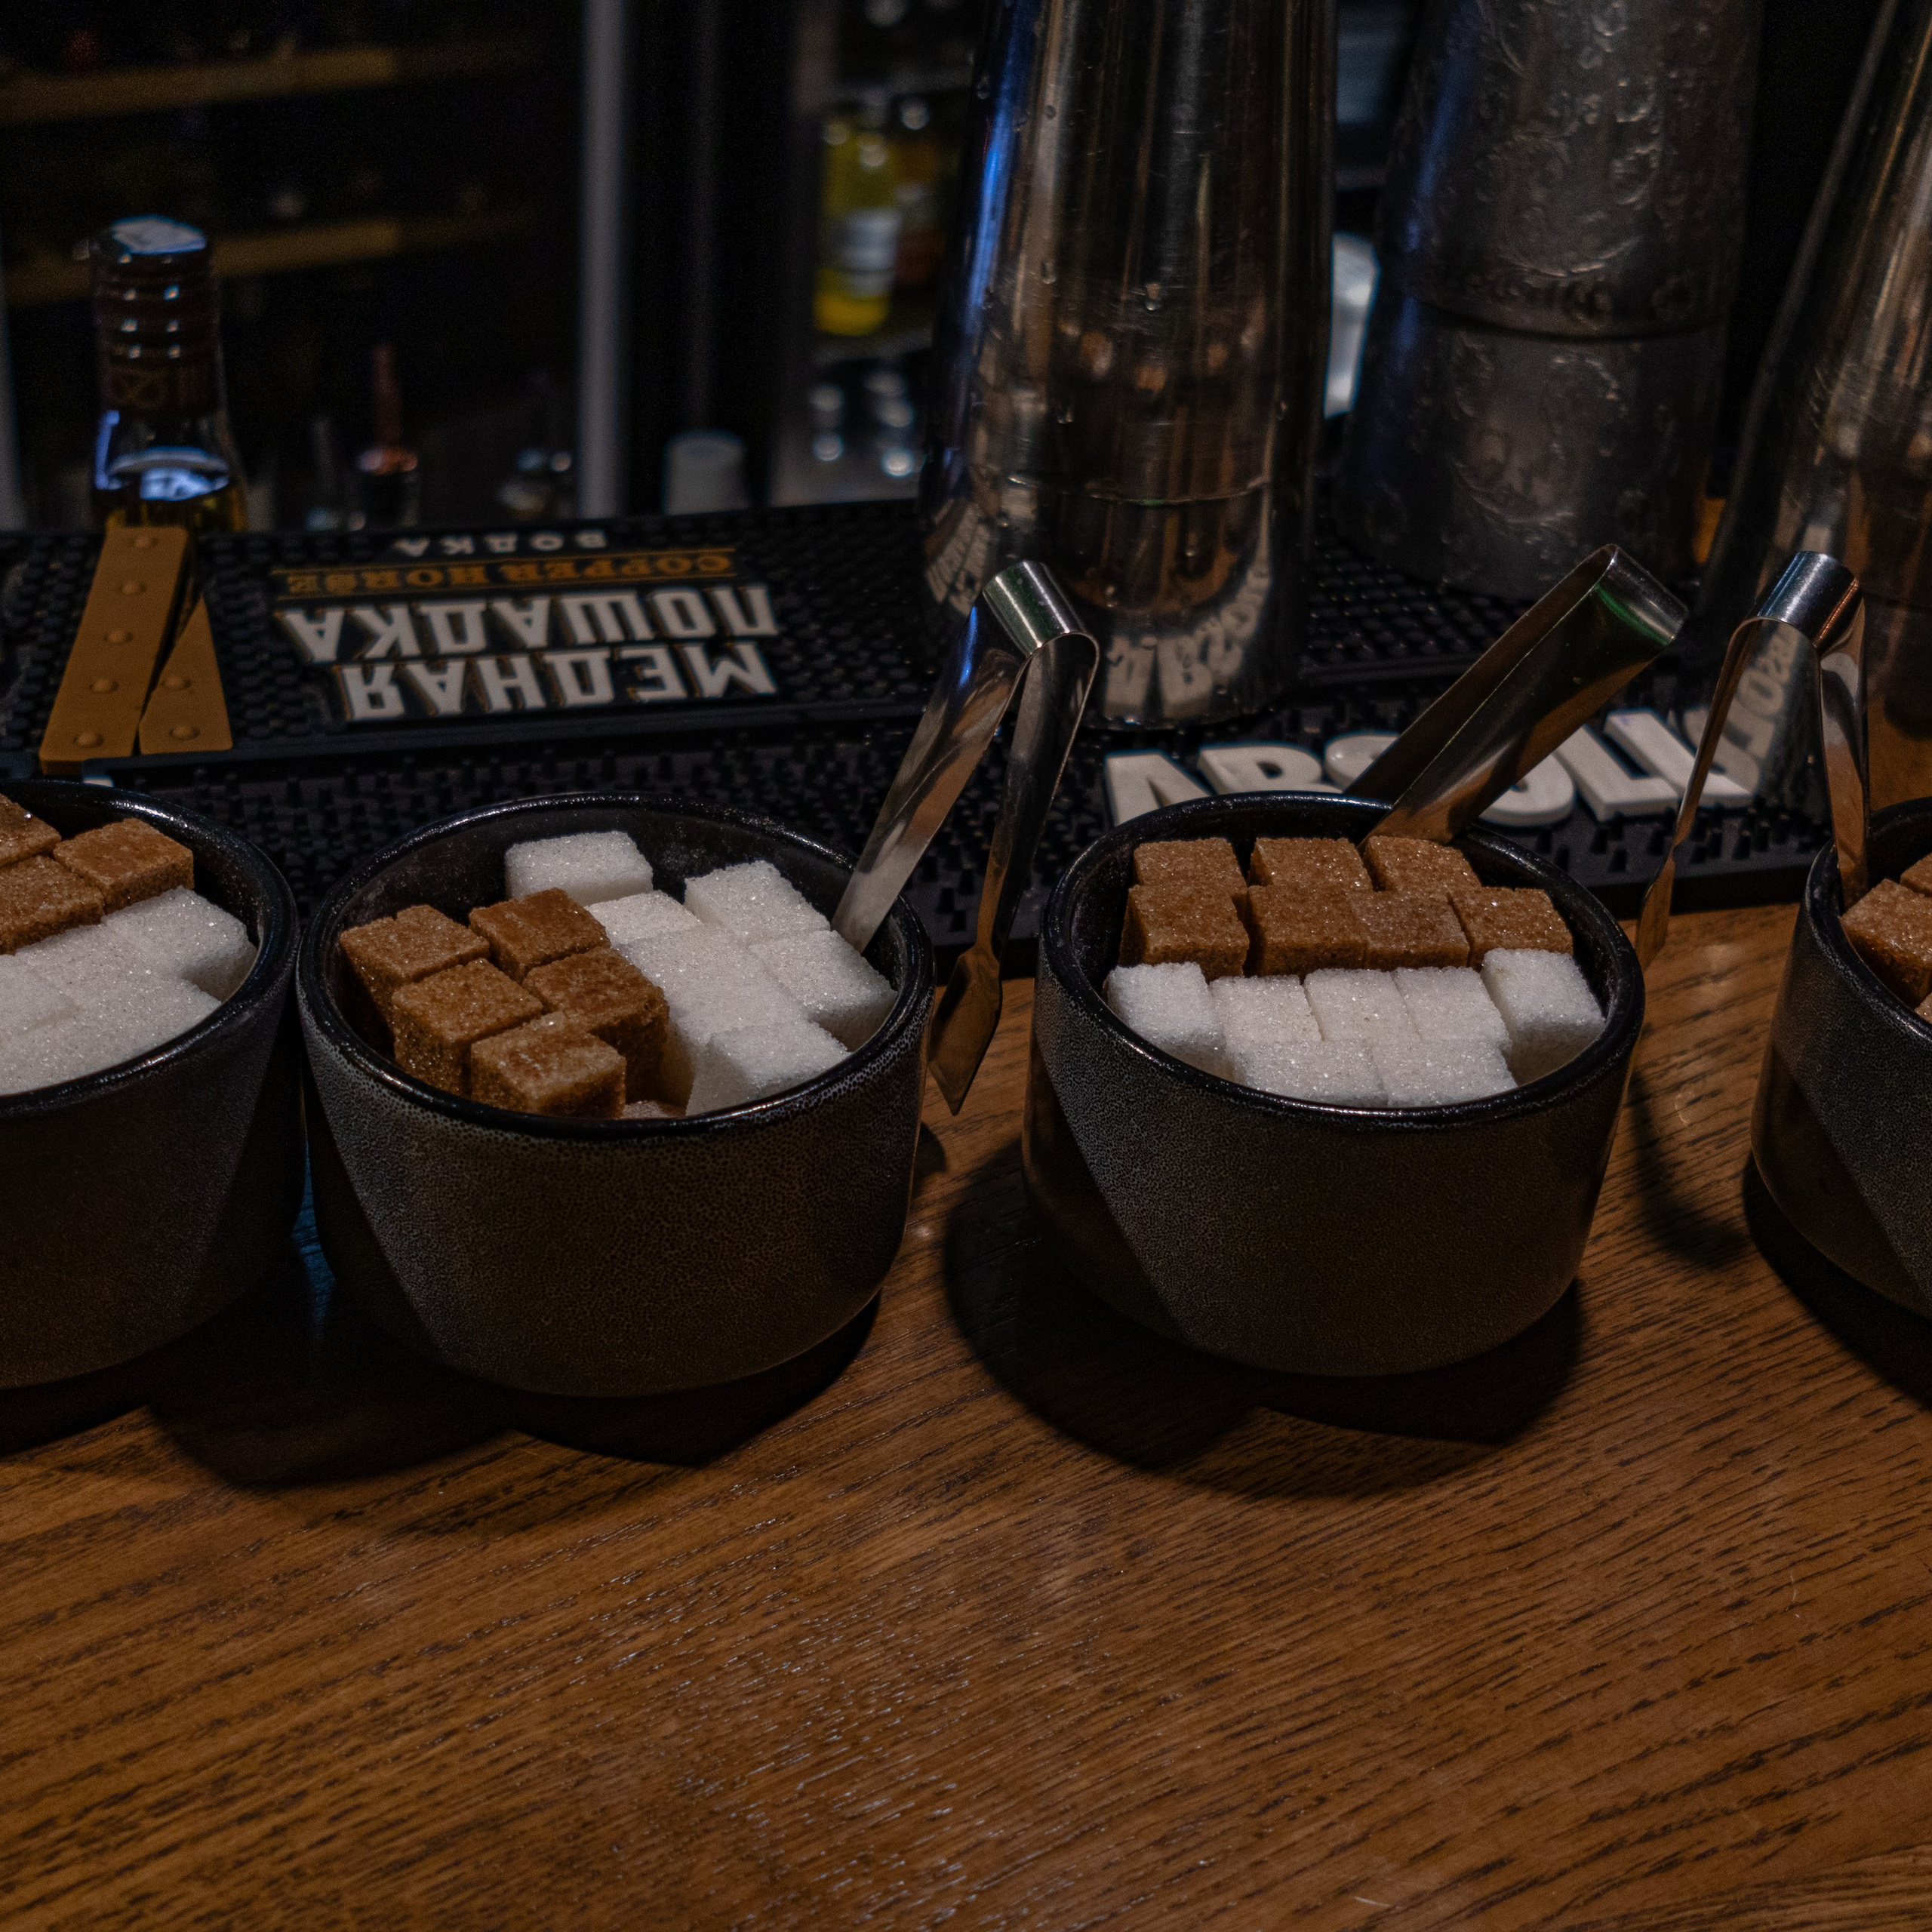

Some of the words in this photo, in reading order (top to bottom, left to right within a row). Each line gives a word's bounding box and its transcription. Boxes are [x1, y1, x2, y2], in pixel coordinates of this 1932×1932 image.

[392, 530, 608, 557] ВОДКА
[287, 565, 489, 594] HORSE
[497, 555, 732, 583] COPPER
[335, 640, 778, 721] МЕДНАЯ
[1103, 706, 1757, 827] ABLU
